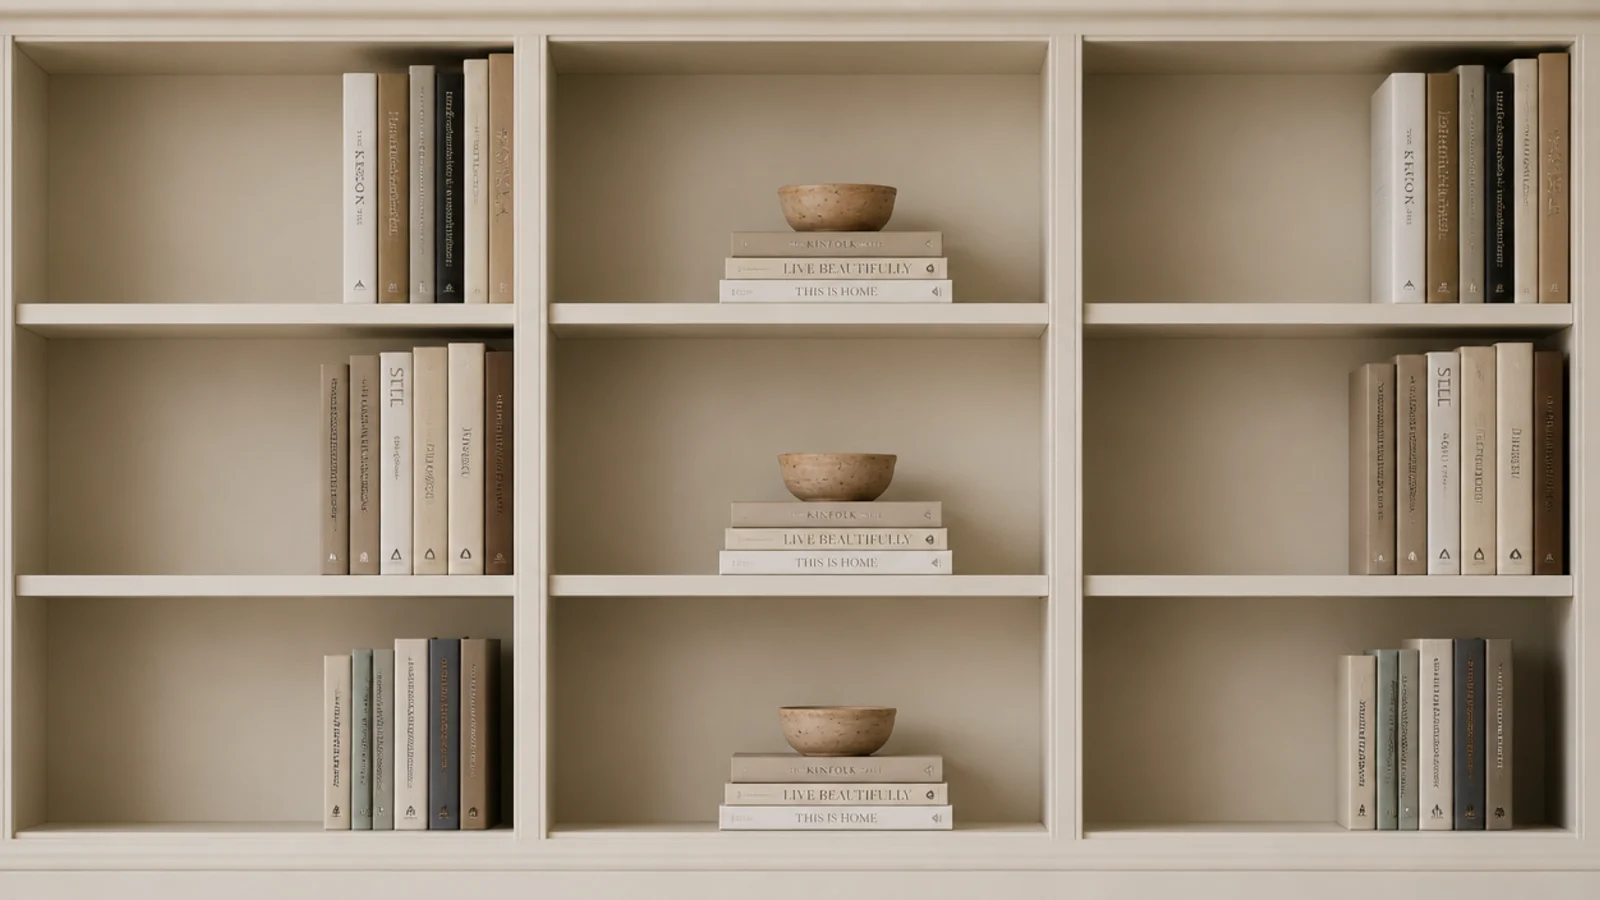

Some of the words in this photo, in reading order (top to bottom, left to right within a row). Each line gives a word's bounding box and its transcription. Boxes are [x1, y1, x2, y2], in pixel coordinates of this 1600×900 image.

[806, 240, 857, 249] KINFOLK
[783, 263, 815, 274] LIVE
[819, 263, 912, 274] BEAUTIFULLY
[795, 287, 824, 297] THIS
[827, 287, 838, 297] IS
[841, 287, 878, 297] HOME
[806, 511, 857, 519] KINFOLK
[783, 534, 815, 545] LIVE
[819, 534, 912, 545] BEAUTIFULLY
[795, 558, 824, 568] THIS
[827, 558, 838, 568] IS
[841, 558, 878, 568] HOME
[806, 766, 857, 775] KINFOLK
[783, 789, 815, 801] LIVE
[819, 789, 912, 801] BEAUTIFULLY
[795, 813, 824, 823] THIS
[827, 813, 838, 823] IS
[841, 813, 878, 823] HOME
